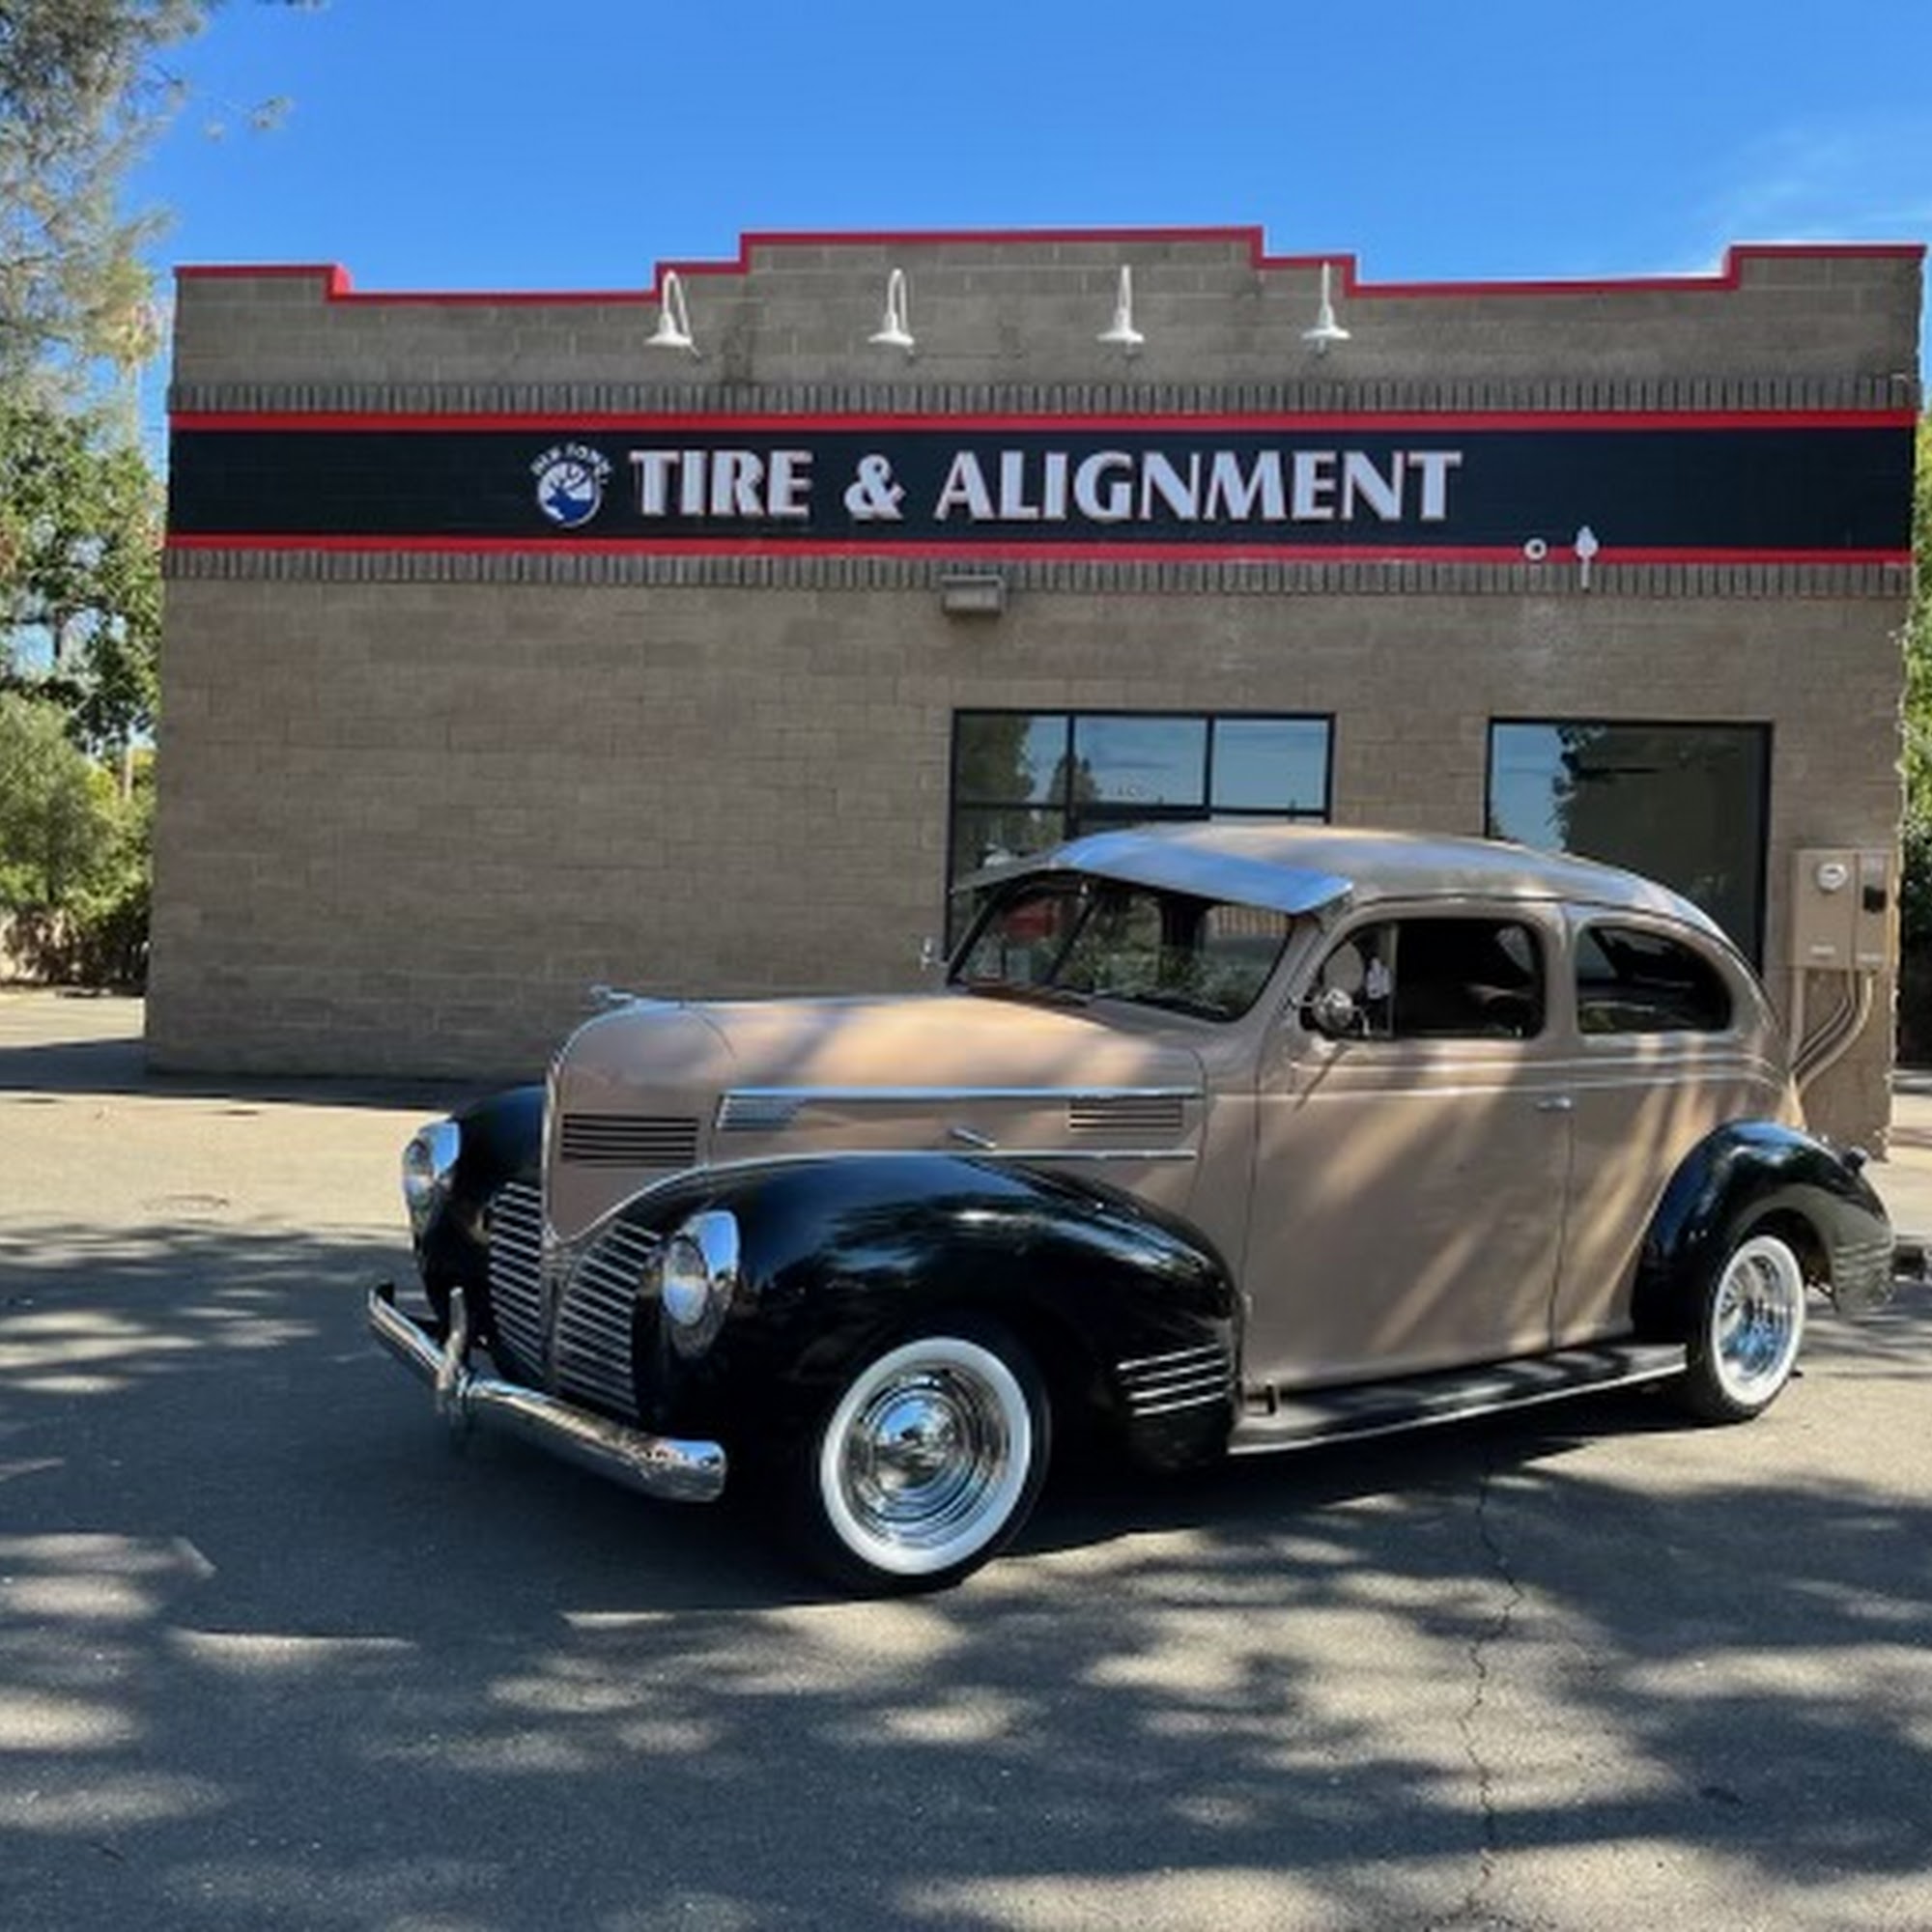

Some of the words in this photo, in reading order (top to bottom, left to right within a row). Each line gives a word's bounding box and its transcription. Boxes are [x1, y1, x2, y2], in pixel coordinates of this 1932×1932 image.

[629, 450, 812, 516] TIRE
[843, 454, 904, 520] &
[933, 450, 1462, 521] ALIGNMENT
